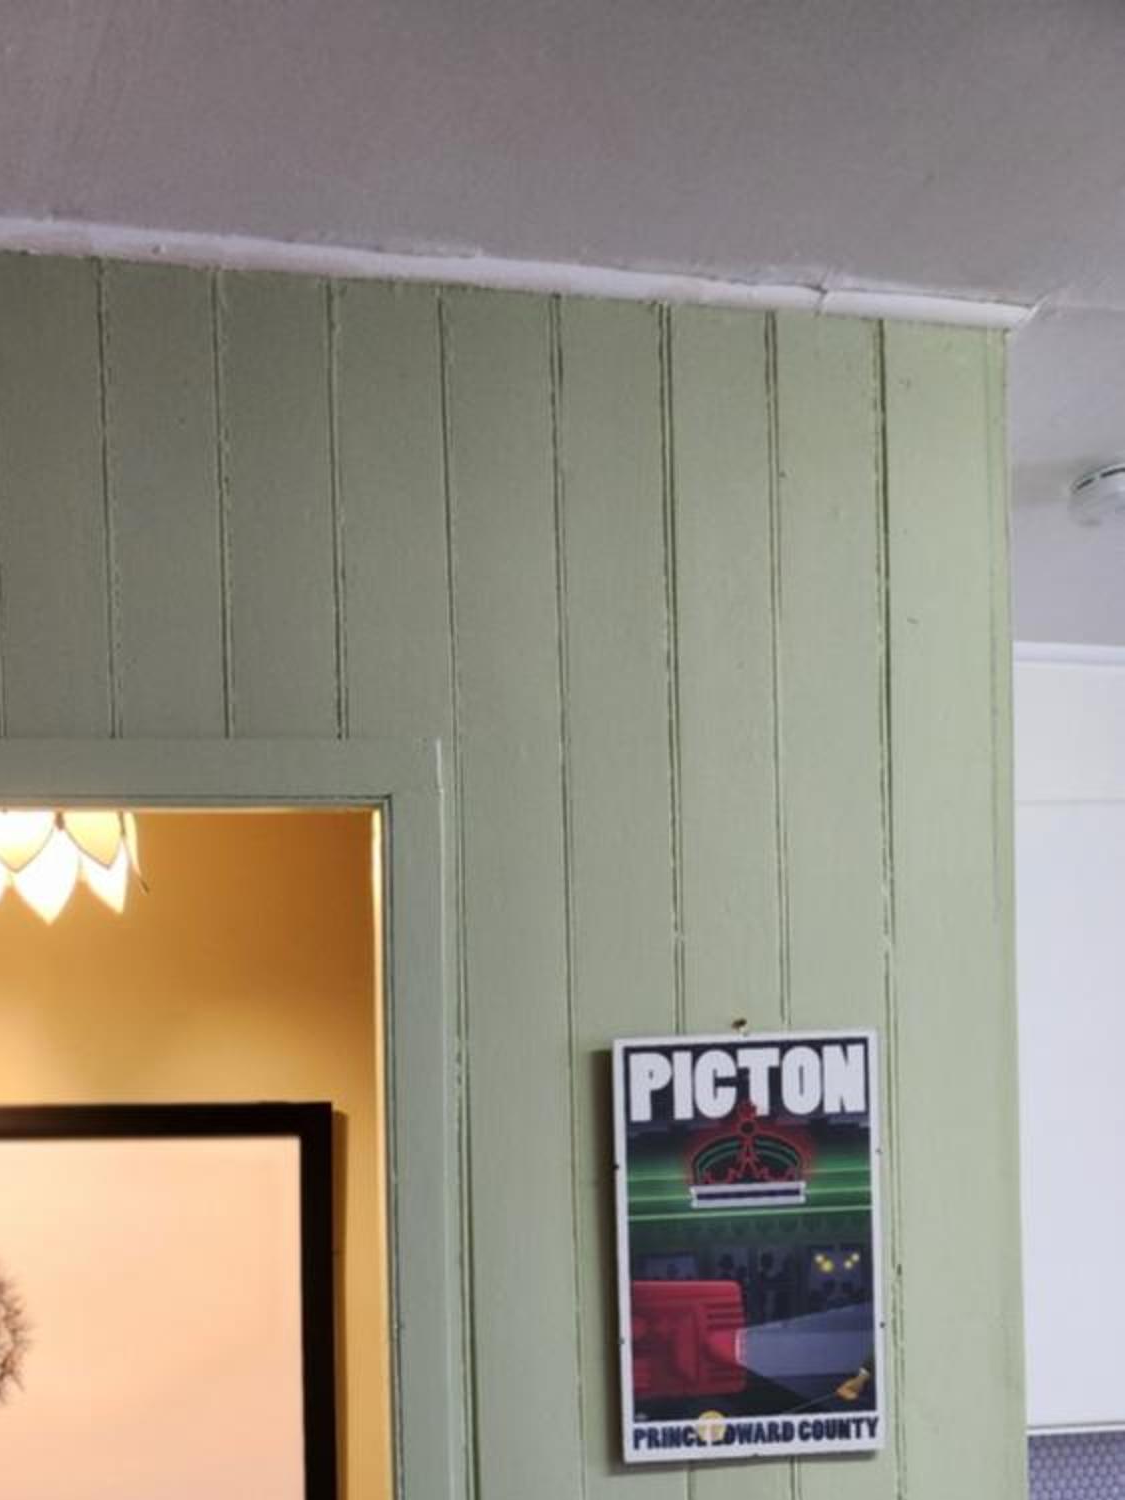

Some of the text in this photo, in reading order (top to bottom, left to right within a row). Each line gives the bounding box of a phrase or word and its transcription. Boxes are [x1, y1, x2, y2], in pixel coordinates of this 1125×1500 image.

[628, 1043, 867, 1122] PICTON
[711, 1421, 795, 1446] DWARD
[798, 1417, 879, 1441] COUNTY
